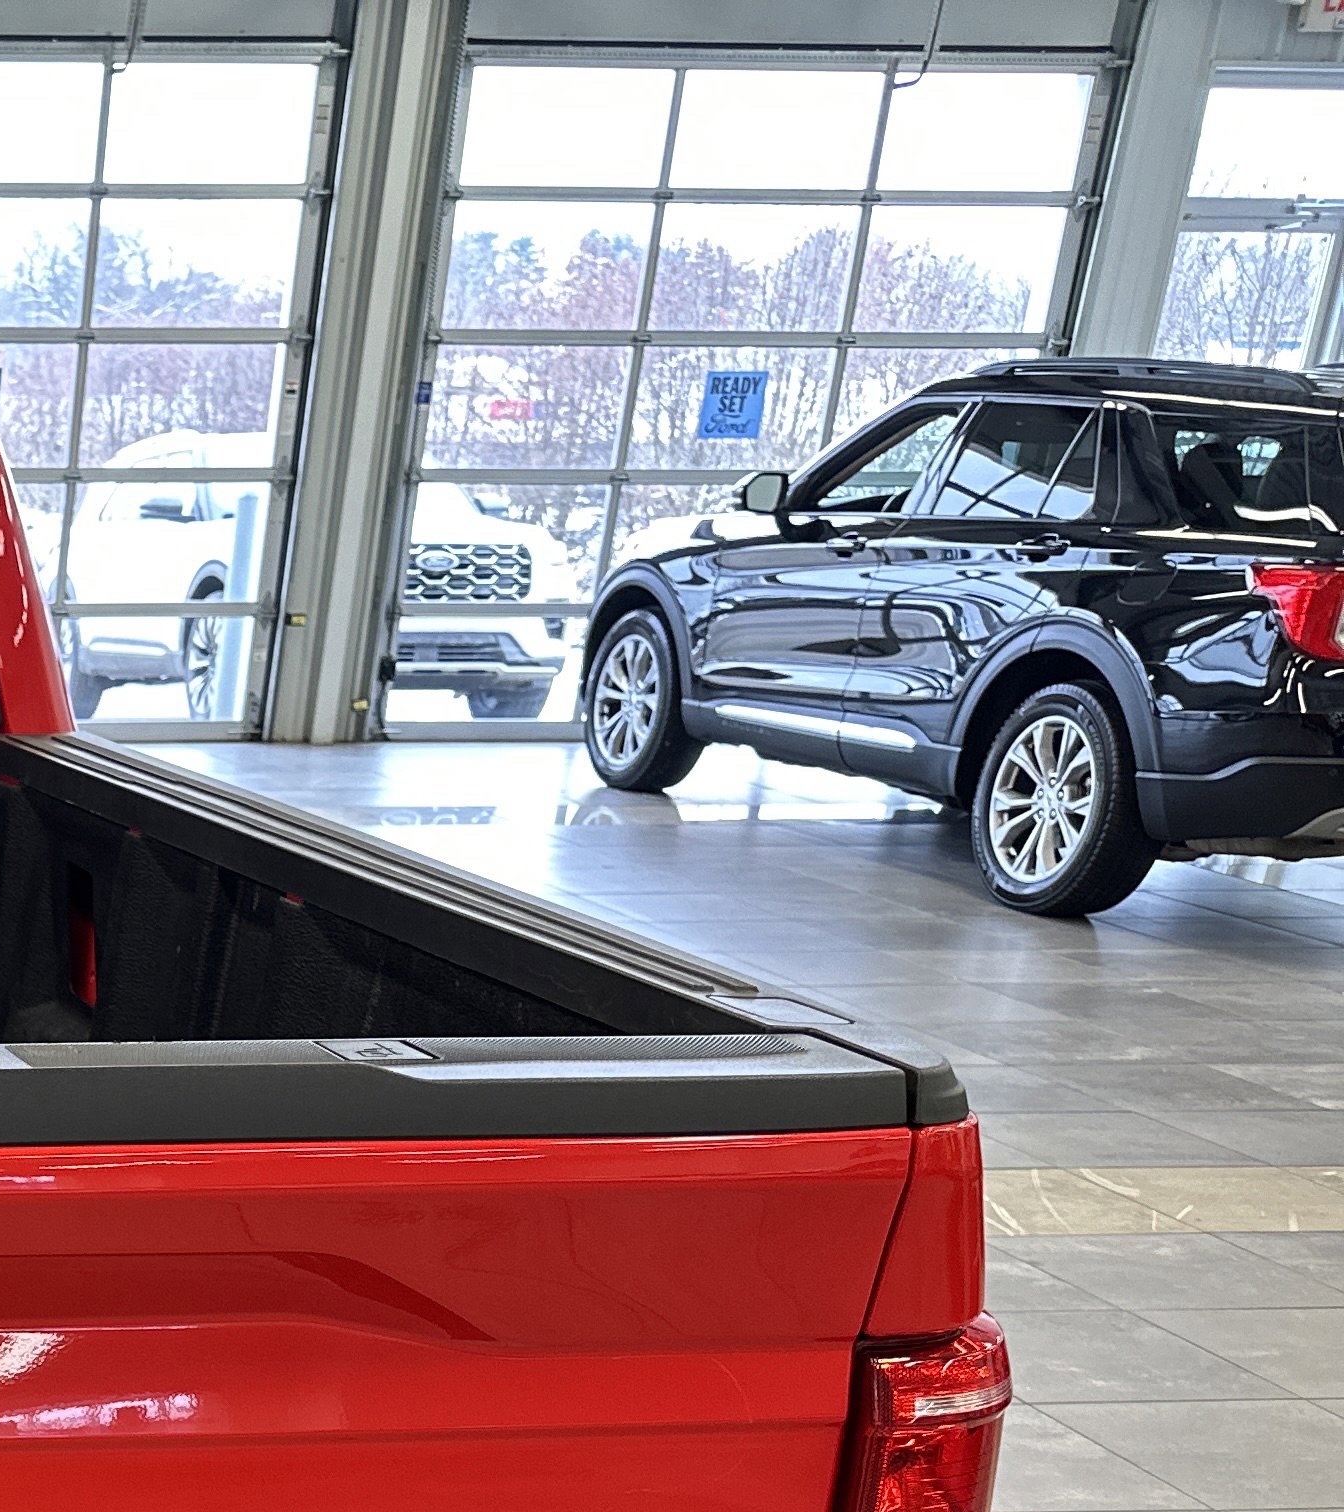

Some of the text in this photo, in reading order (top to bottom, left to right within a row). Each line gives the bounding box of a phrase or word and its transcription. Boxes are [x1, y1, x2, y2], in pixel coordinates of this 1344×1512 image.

[710, 376, 762, 395] READY
[718, 395, 747, 414] SET
[703, 413, 755, 434] Ford
